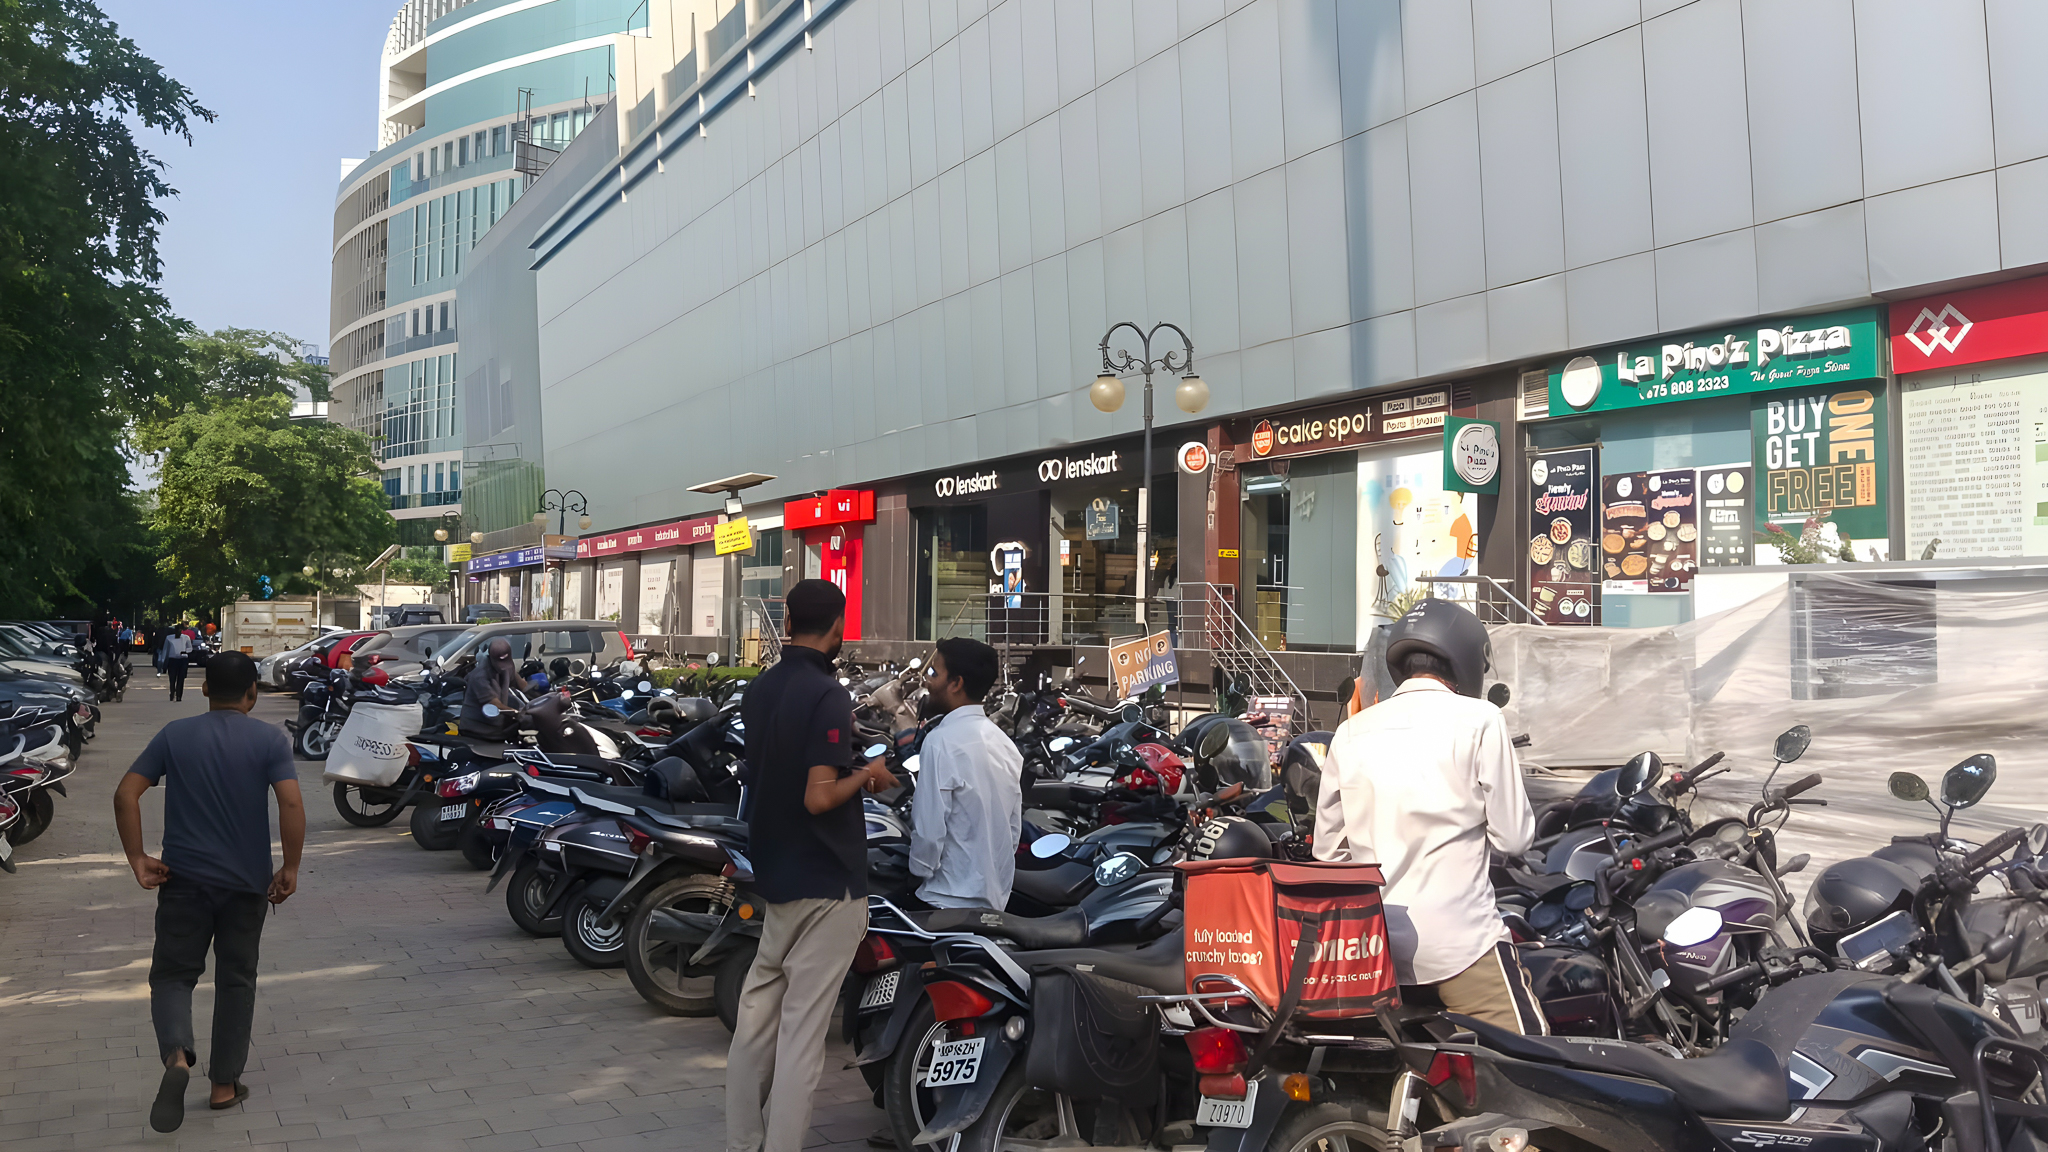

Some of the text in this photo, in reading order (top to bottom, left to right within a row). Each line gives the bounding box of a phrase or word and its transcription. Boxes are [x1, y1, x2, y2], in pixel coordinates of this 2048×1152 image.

[1617, 352, 1655, 383] La
[1757, 325, 1852, 367] Pizza
[1670, 379, 1694, 395] 808
[1697, 375, 1729, 392] 2323
[1277, 418, 1323, 445] cake
[1329, 407, 1373, 442] spot
[1767, 395, 1827, 435] BUY
[1828, 390, 1874, 463] ONE
[1066, 450, 1117, 479] lenskart
[1766, 431, 1820, 469] GET
[956, 470, 997, 496] lenskart
[1767, 464, 1855, 512] FREE
[838, 499, 850, 512] vi
[1125, 647, 1151, 665] NO
[1121, 660, 1174, 692] PARKING
[931, 1058, 977, 1083] 5975
